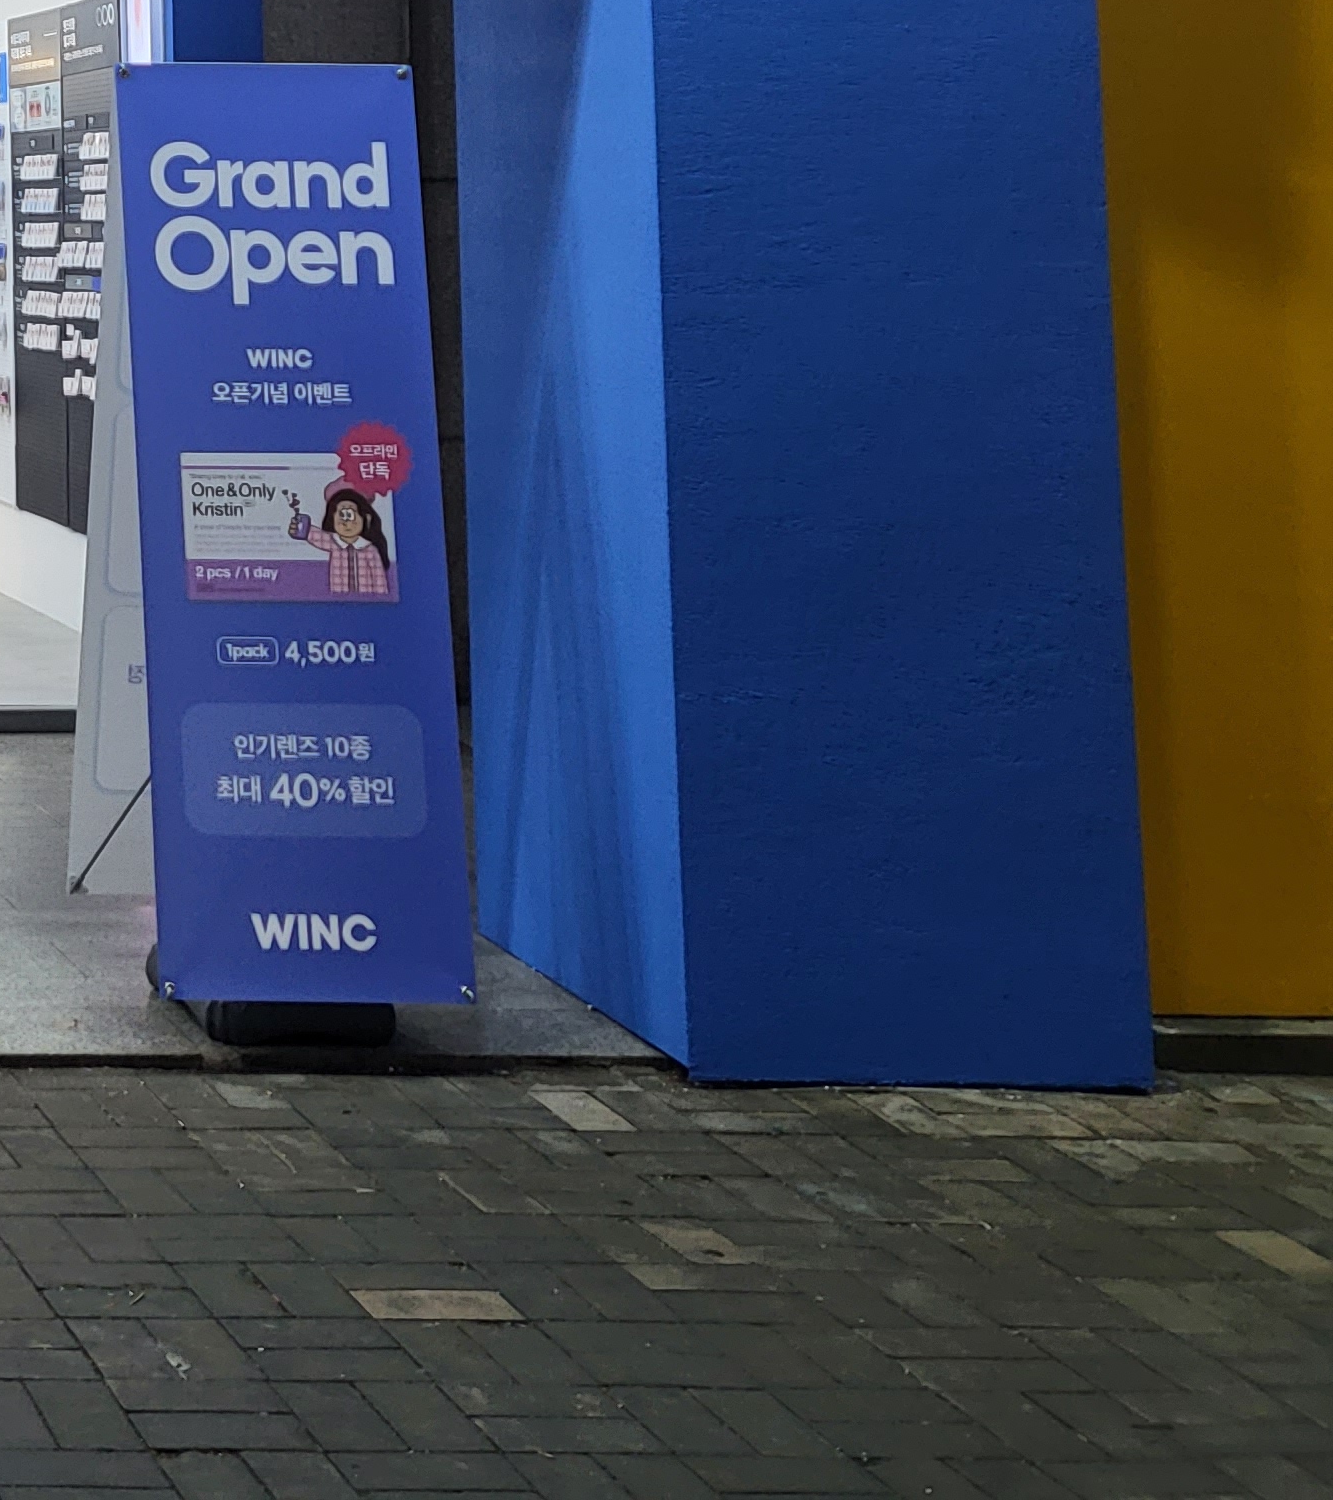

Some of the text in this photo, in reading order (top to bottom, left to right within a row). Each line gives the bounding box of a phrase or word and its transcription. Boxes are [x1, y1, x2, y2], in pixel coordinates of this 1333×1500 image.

[149, 140, 391, 209] Grand
[154, 215, 395, 305] Open
[246, 349, 313, 369] WINC
[212, 382, 353, 406] 오픈기념 이벤트
[348, 444, 399, 459] 오프라인
[359, 461, 391, 481] 단독
[192, 501, 245, 517] Kristin
[206, 567, 232, 583] pcs
[253, 566, 279, 582] day
[225, 640, 375, 669] 1pack 4,500원
[233, 734, 372, 760] 인기렌즈 10종
[216, 772, 395, 809] 최대 40% 할인
[249, 912, 377, 952] WINC
